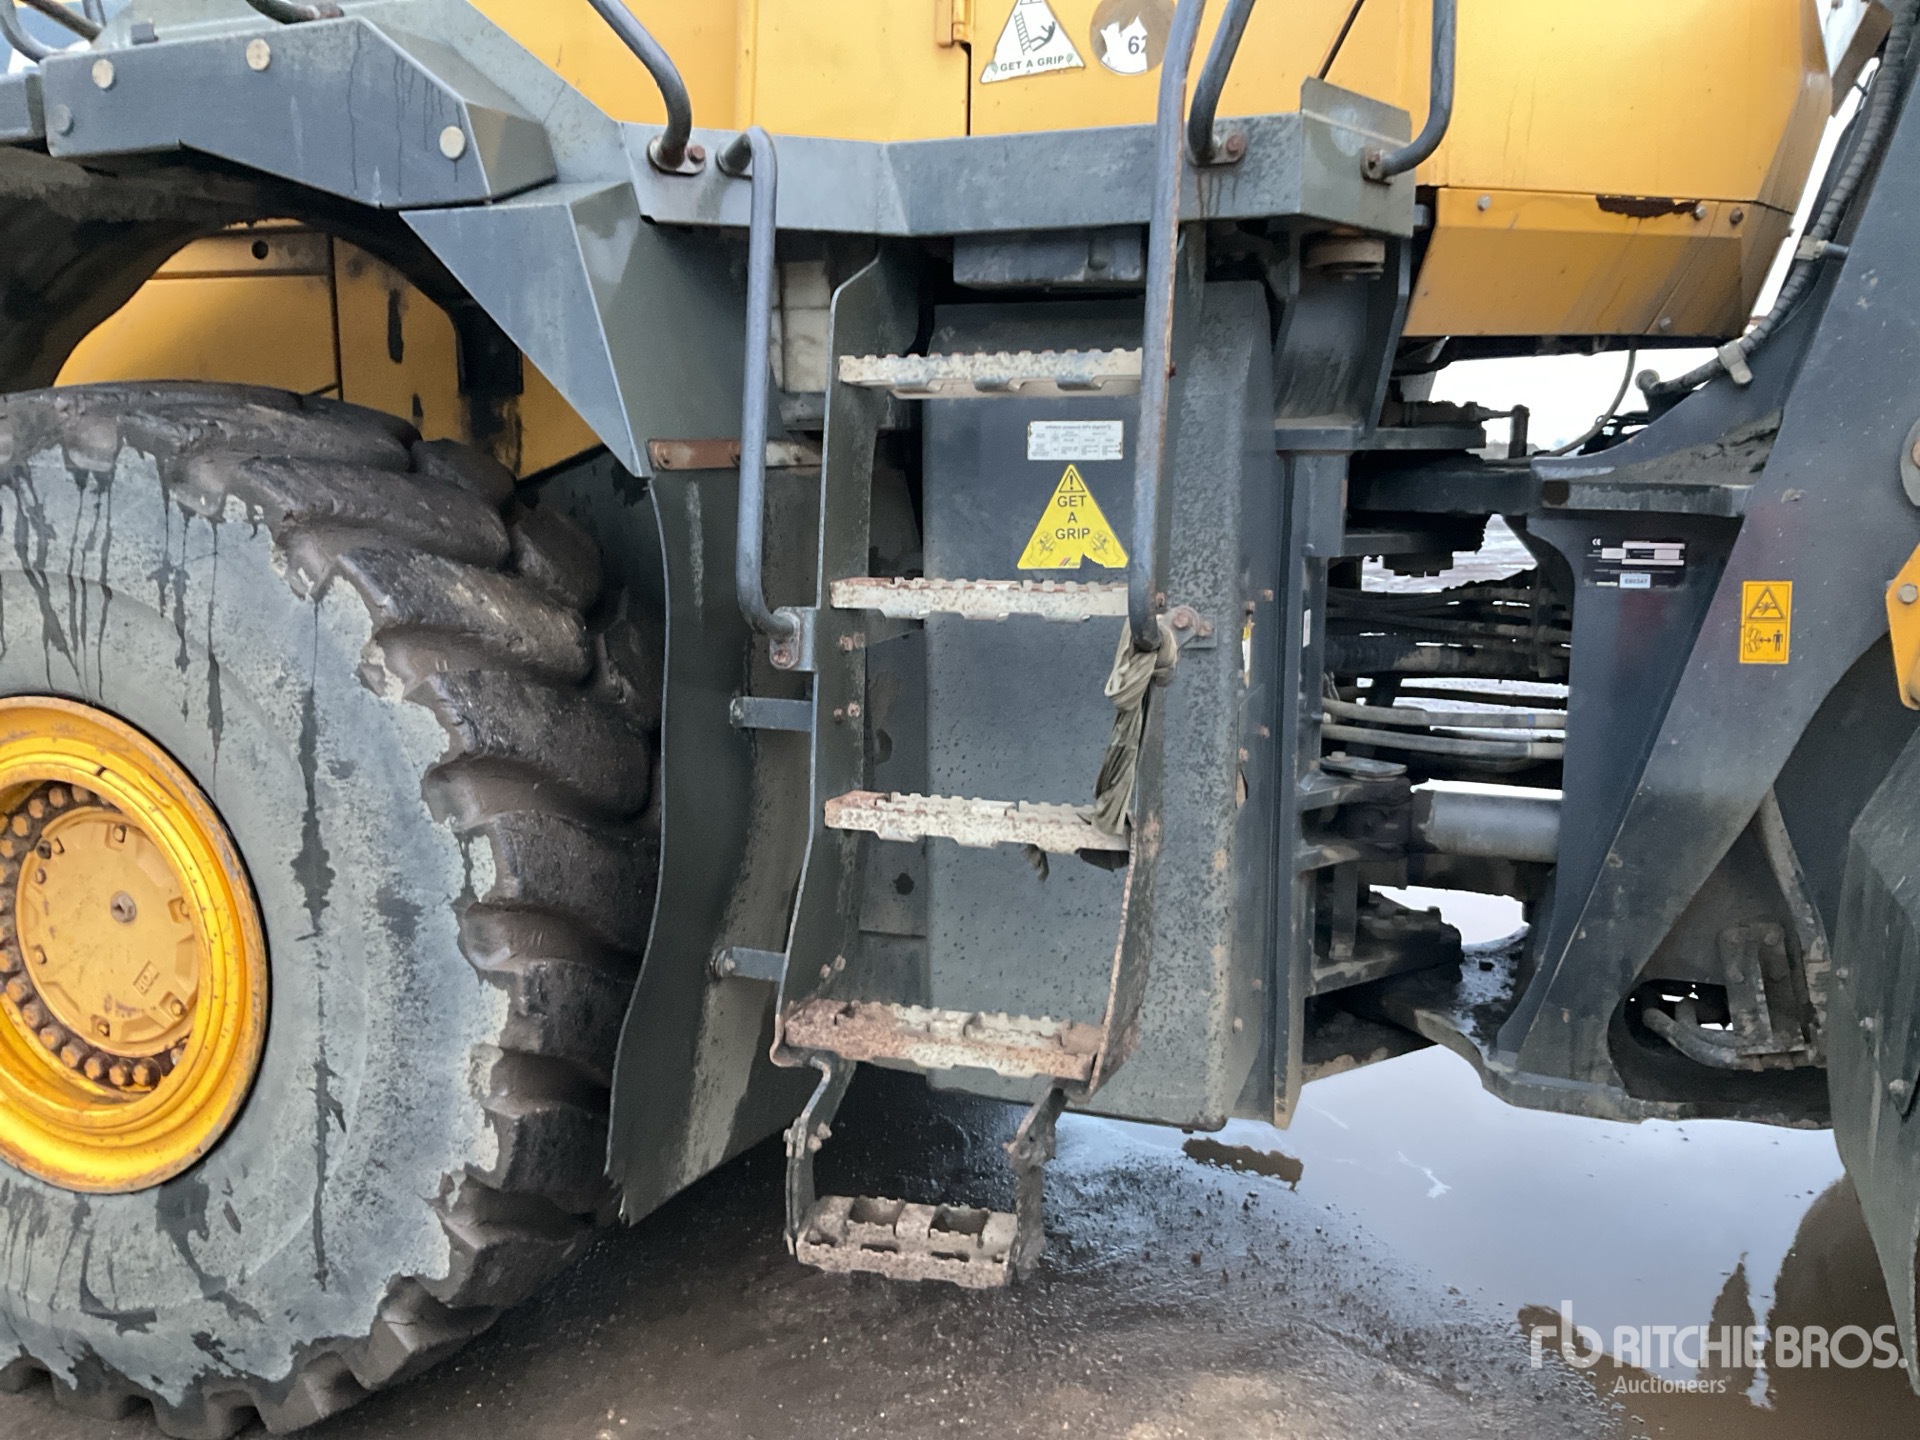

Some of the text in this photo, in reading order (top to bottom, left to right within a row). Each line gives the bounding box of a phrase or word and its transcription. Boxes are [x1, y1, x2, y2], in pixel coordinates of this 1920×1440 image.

[1000, 55, 1065, 72] GET A GRIP
[1057, 495, 1087, 508] GET
[1067, 512, 1078, 523] A
[1055, 528, 1091, 540] GRIP
